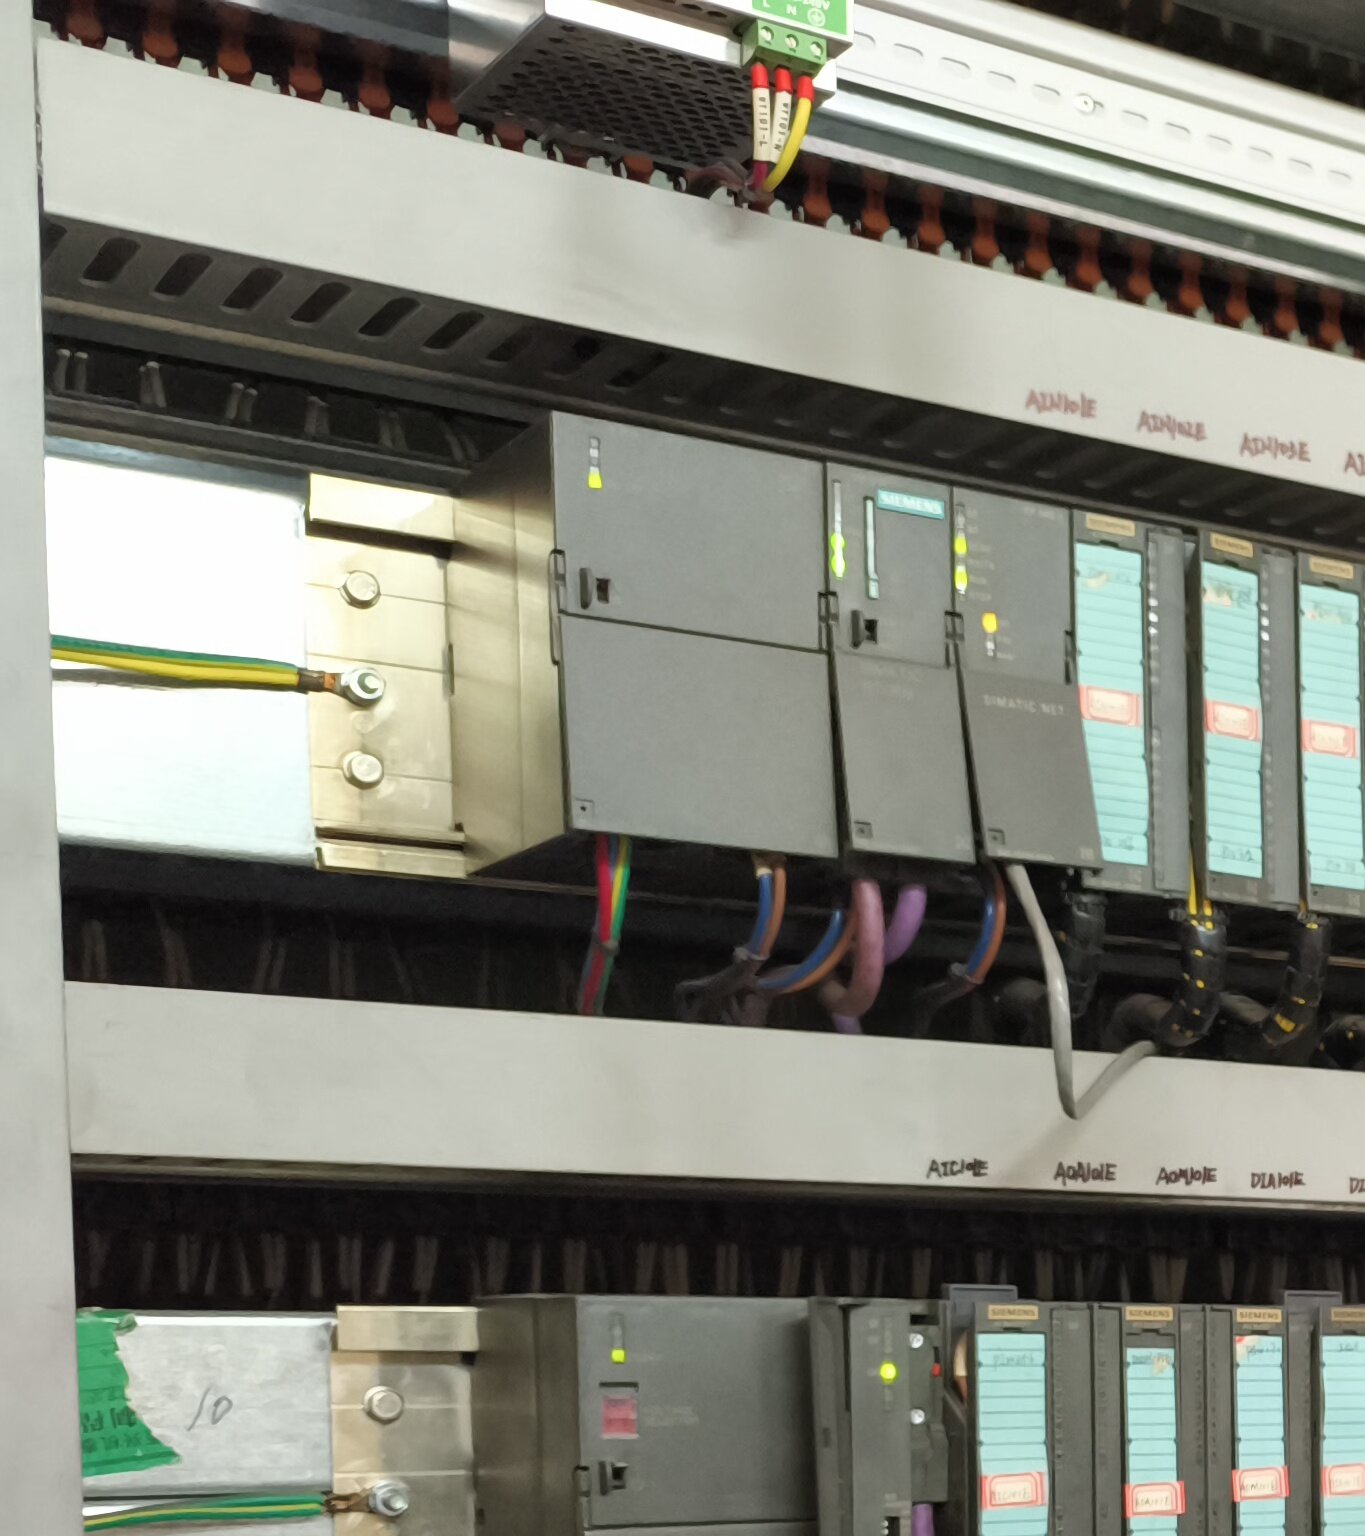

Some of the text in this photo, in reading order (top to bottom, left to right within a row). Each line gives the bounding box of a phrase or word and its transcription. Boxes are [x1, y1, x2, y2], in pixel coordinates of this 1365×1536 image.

[786, 4, 797, 16] N
[880, 492, 943, 514] SIEMENS
[990, 1307, 1036, 1318] SIEMENS
[1127, 1309, 1172, 1319] SIEMENS
[1238, 1311, 1280, 1320] SIEMENS
[187, 1385, 234, 1432] 10
